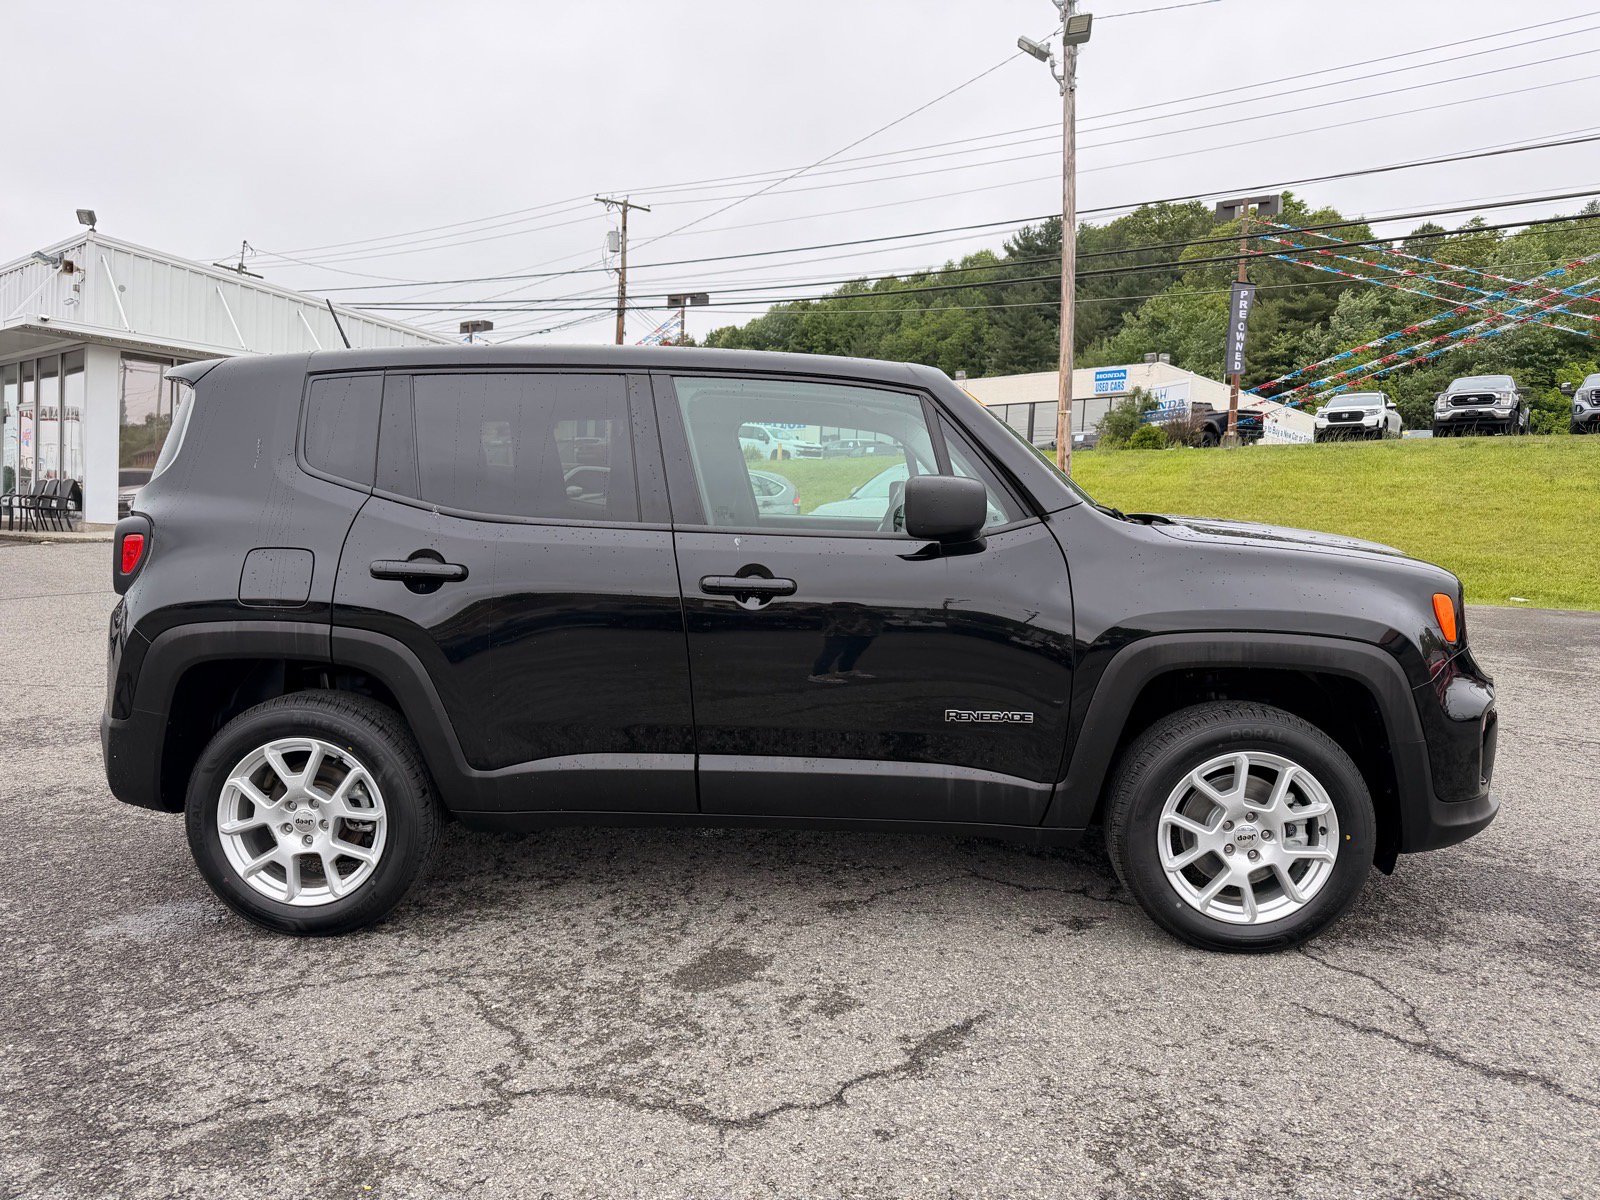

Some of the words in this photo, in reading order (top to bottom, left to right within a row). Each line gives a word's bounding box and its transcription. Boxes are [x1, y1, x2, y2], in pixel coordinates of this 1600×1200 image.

[1239, 290, 1249, 319] PRE
[1234, 322, 1246, 371] OWNED
[1096, 372, 1126, 380] HONDA
[1095, 382, 1109, 393] USED
[1110, 380, 1125, 391] CARS
[945, 709, 1034, 724] RENEGADE
[1230, 727, 1285, 744] DORAL
[295, 817, 314, 826] Jeep
[1237, 833, 1257, 841] Jeep
